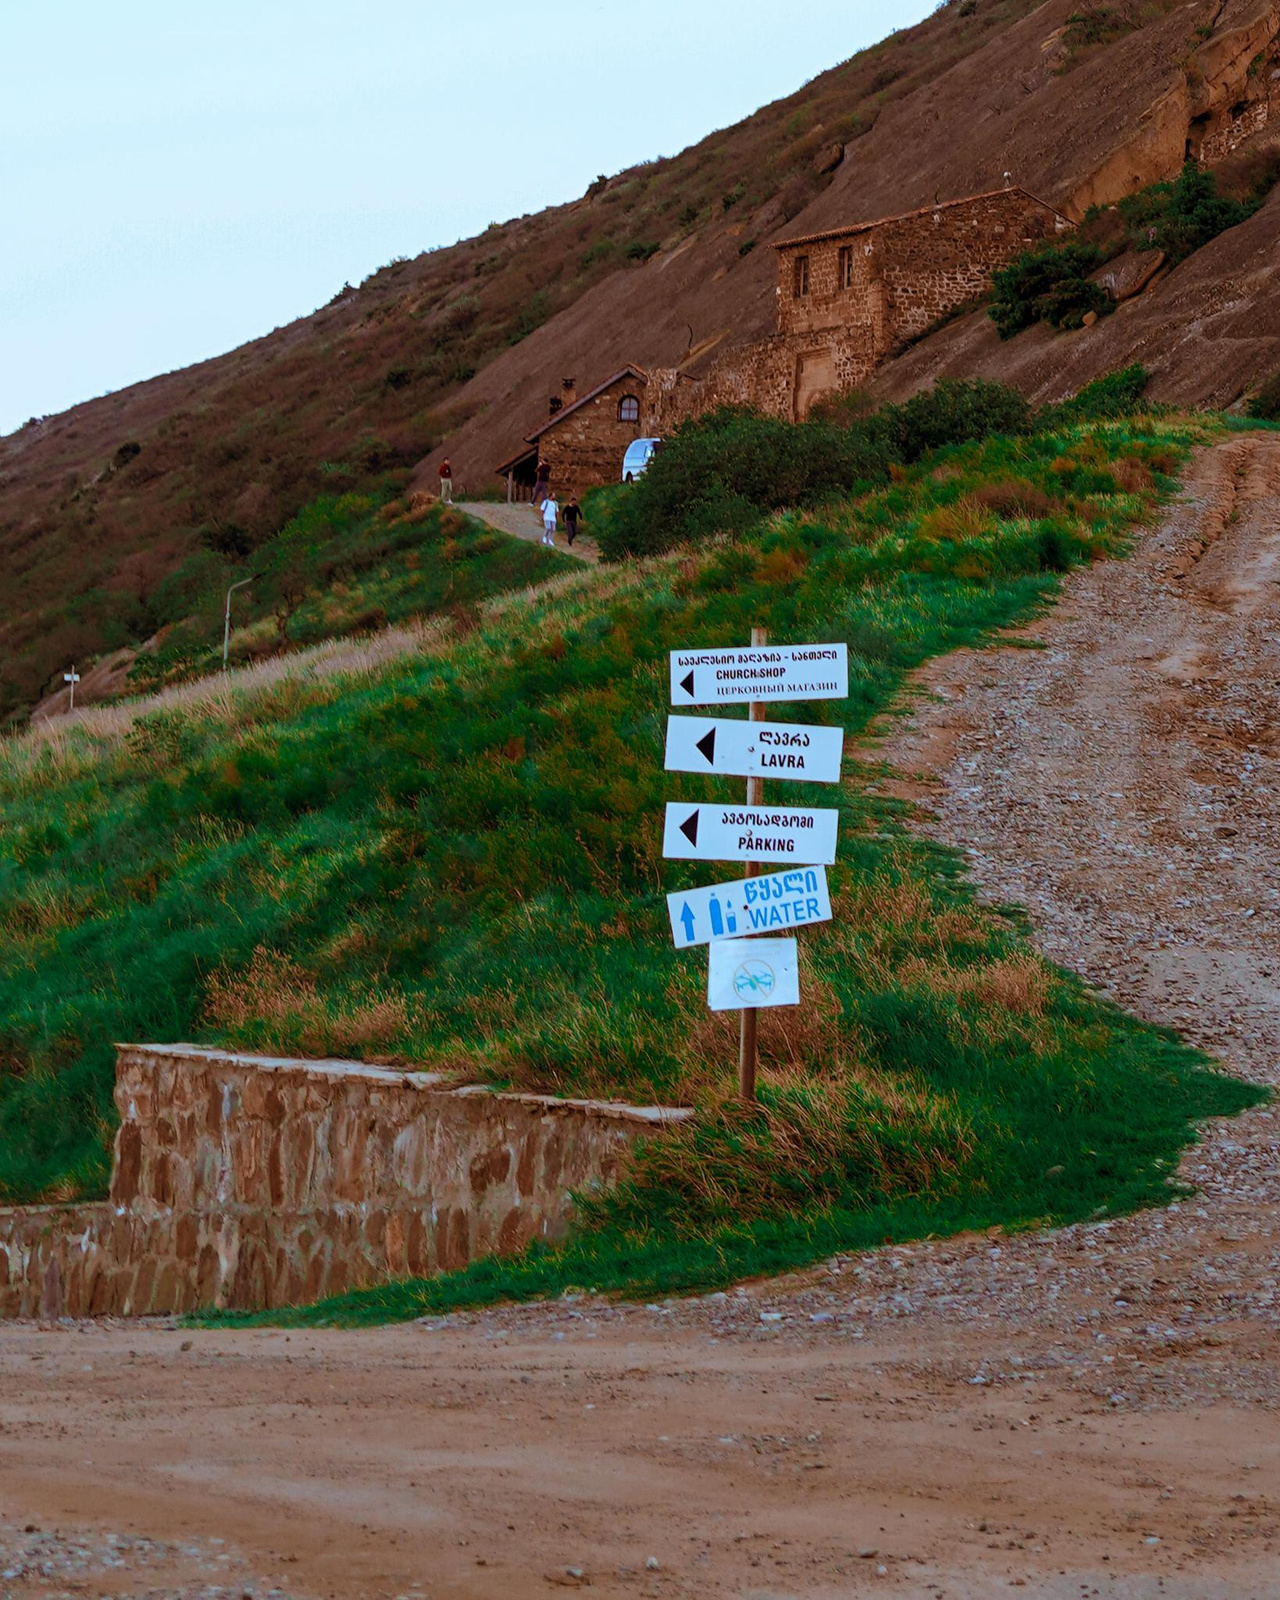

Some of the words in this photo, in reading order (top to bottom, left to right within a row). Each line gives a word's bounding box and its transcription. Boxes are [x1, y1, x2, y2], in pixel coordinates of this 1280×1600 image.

[678, 655, 735, 666] საეკლესიო
[737, 653, 781, 664] მაღაზია
[792, 650, 838, 661] სანთელი
[716, 668, 757, 680] CHURCH
[759, 668, 786, 679] SHOP
[717, 683, 785, 696] ЦЕРКОВНЫЙ
[787, 682, 838, 693] МАГАЗИН
[759, 731, 810, 747] ლავრა
[761, 753, 805, 769] LAVRA
[720, 812, 814, 828] ავტოსადგომი
[738, 837, 795, 852] PARKING
[744, 870, 818, 904] წყალი
[748, 898, 822, 928] WATER
